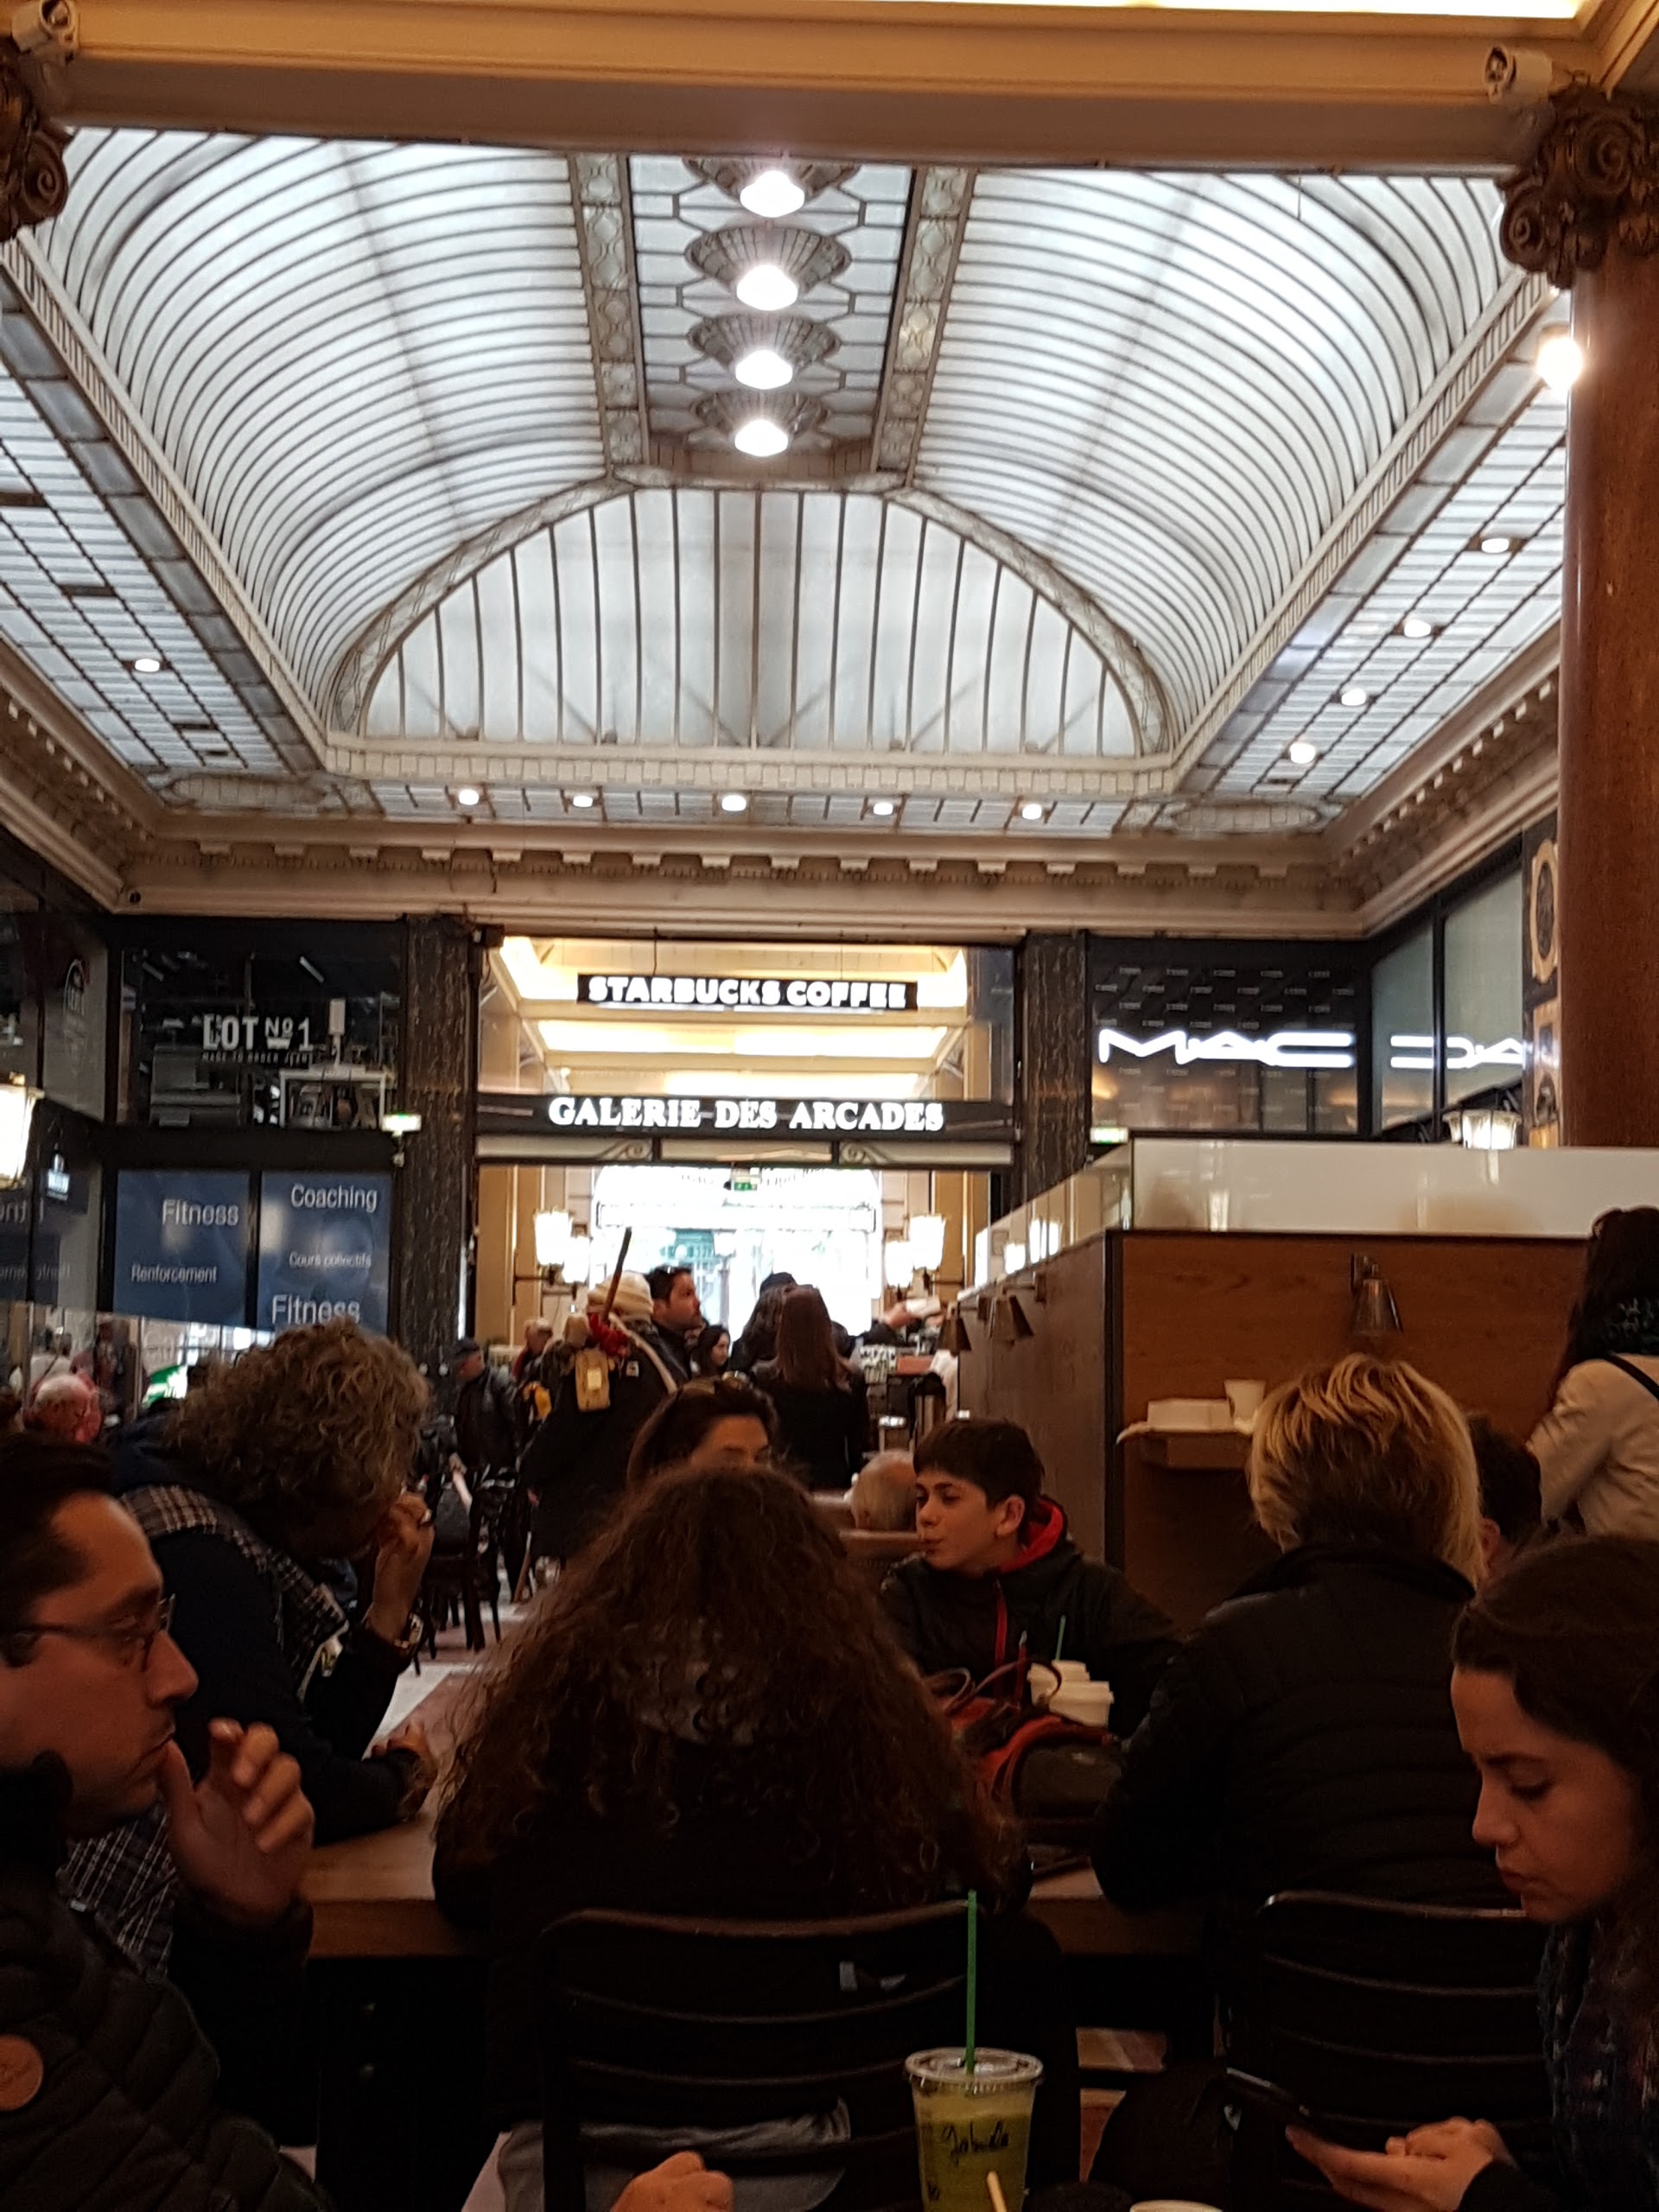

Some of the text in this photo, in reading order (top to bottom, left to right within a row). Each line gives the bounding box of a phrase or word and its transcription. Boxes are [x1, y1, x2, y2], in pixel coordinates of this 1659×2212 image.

[588, 976, 906, 1008] STARBUCKS COFFEE
[203, 1014, 259, 1051] LOT
[548, 1097, 944, 1132] GALERIE DES ARCADES
[161, 1198, 239, 1227] Fitness
[290, 1183, 378, 1214] Coaching
[130, 1262, 218, 1284] Renforcement
